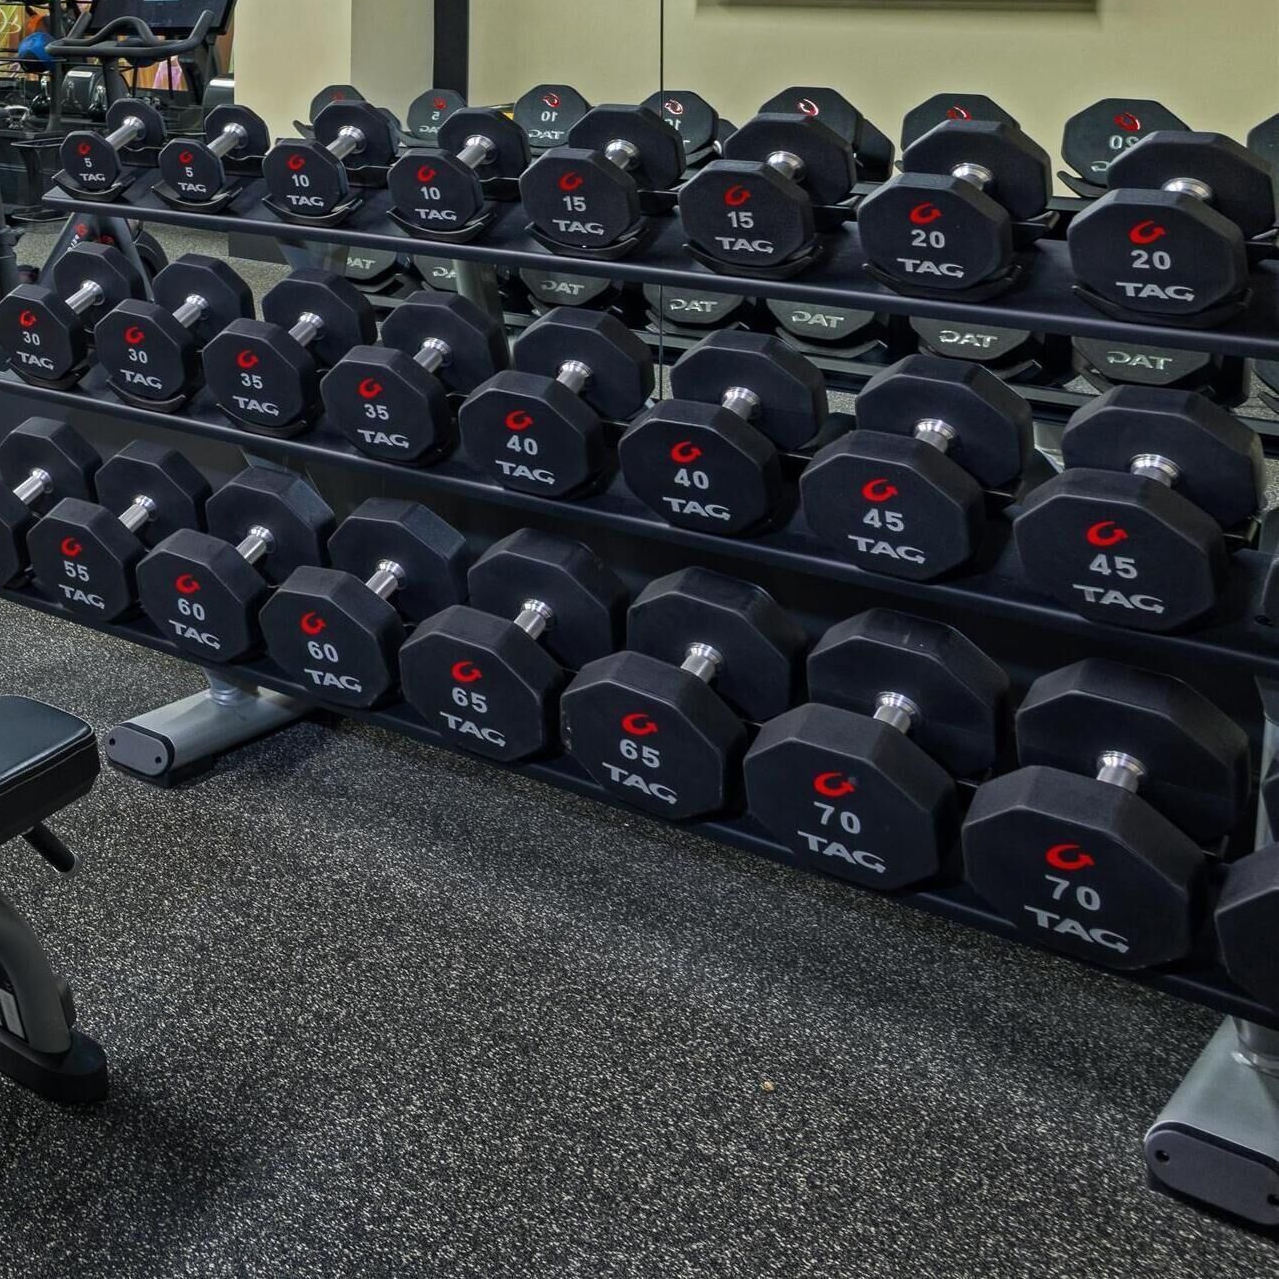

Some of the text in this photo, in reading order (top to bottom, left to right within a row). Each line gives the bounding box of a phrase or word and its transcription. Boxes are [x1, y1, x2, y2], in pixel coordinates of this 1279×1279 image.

[84, 157, 93, 168] 5
[185, 166, 194, 178] 5
[79, 173, 106, 182] TAG
[177, 182, 207, 193] TAG
[291, 174, 310, 187] 10
[286, 194, 325, 207] TAG
[420, 186, 441, 200] 10
[562, 195, 587, 212] 15
[414, 208, 457, 221] TAG
[727, 211, 754, 229] 15
[552, 219, 605, 236] TAG
[714, 236, 774, 254] TAG
[911, 229, 945, 249] 20
[896, 257, 965, 279] TAG
[1130, 249, 1171, 270] 20
[1115, 281, 1195, 302] TAG
[22, 331, 41, 346] 30
[16, 350, 54, 370] TAG
[128, 348, 148, 364] 30
[120, 368, 163, 390] TAG
[240, 372, 263, 390] 35
[232, 395, 280, 417] TAG
[364, 403, 389, 421] 35
[357, 428, 410, 449] TAG
[506, 434, 538, 456] 40
[494, 459, 556, 485] TAG
[674, 468, 709, 490] 40
[662, 496, 731, 521] TAG
[862, 508, 905, 532] 45
[847, 534, 926, 566] TAG
[63, 560, 90, 582] 55
[1089, 553, 1138, 579] 45
[58, 583, 106, 610] TAG
[1072, 583, 1165, 614] TAG
[177, 598, 205, 621] 60
[168, 619, 221, 650] TAG
[307, 640, 339, 663] 60
[303, 668, 362, 693] TAG
[452, 687, 488, 714] 65
[439, 710, 507, 747] TAG
[618, 737, 661, 769] 65
[601, 761, 678, 805] TAG
[813, 801, 861, 834] 70
[797, 829, 887, 874] TAG
[1045, 874, 1101, 911] 70
[1023, 904, 1130, 954] TAG
